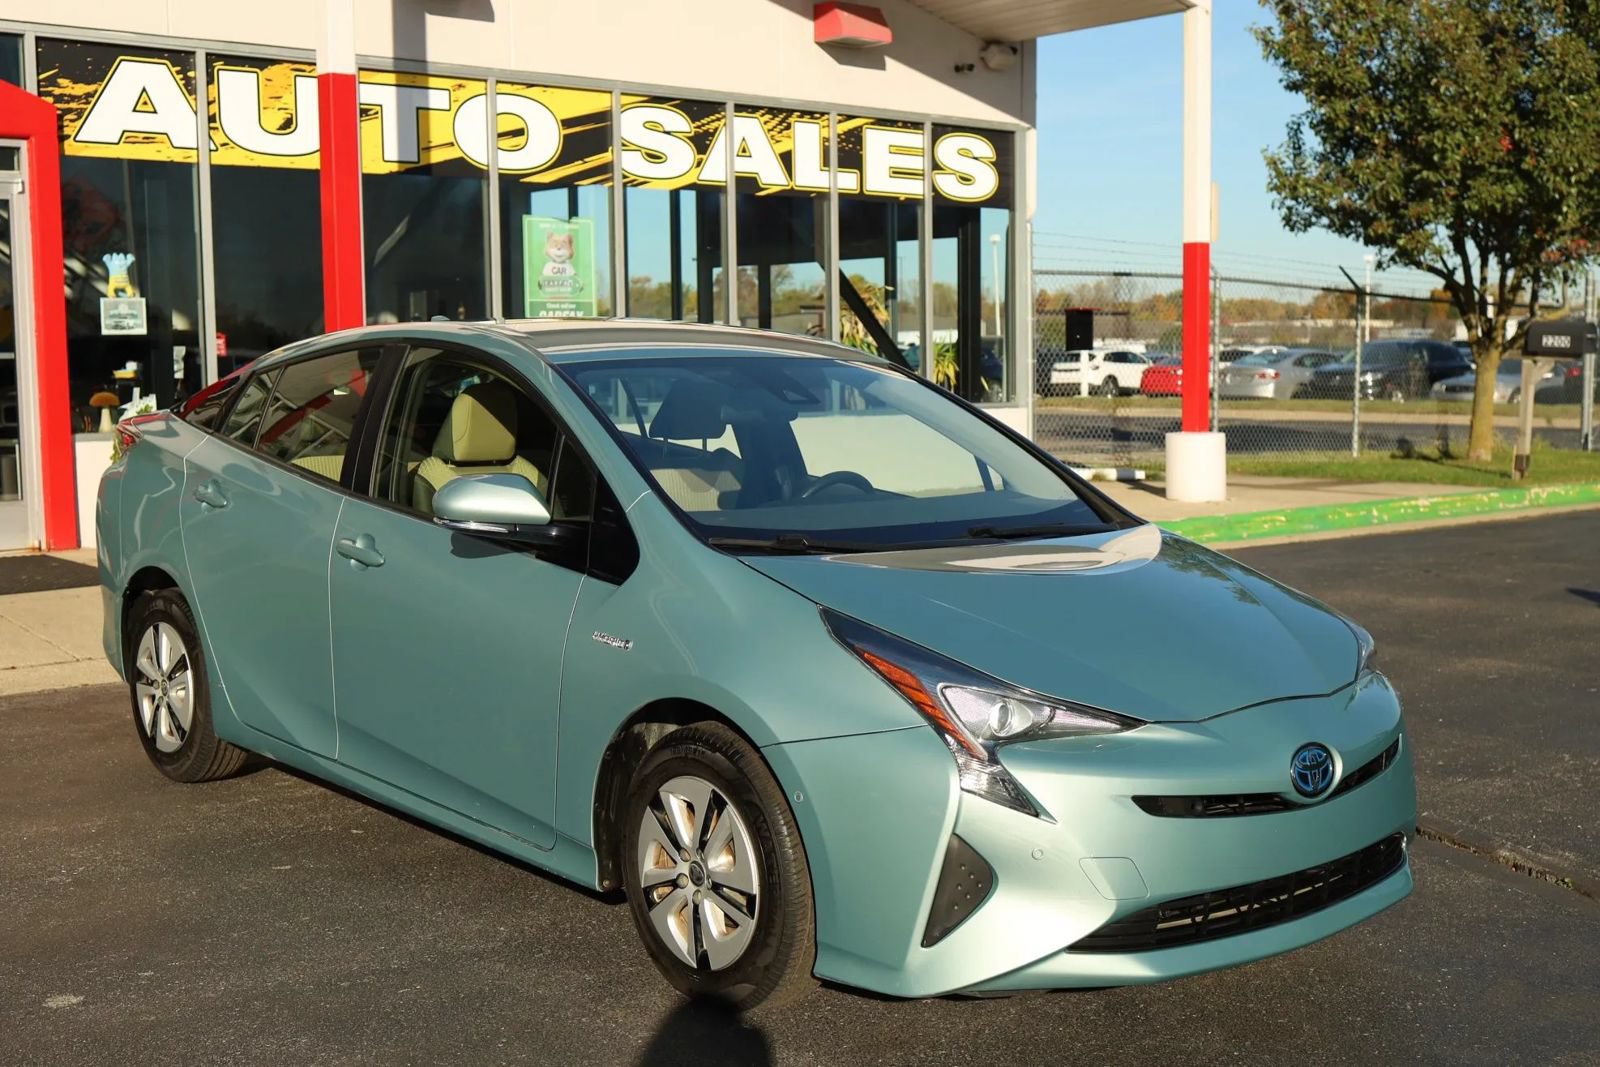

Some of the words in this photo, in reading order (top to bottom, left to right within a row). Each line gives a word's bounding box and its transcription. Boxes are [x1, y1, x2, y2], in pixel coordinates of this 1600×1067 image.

[73, 56, 562, 171] AUTO
[620, 103, 999, 202] SALES
[551, 266, 567, 275] CAR
[1541, 334, 1571, 349] 2200
